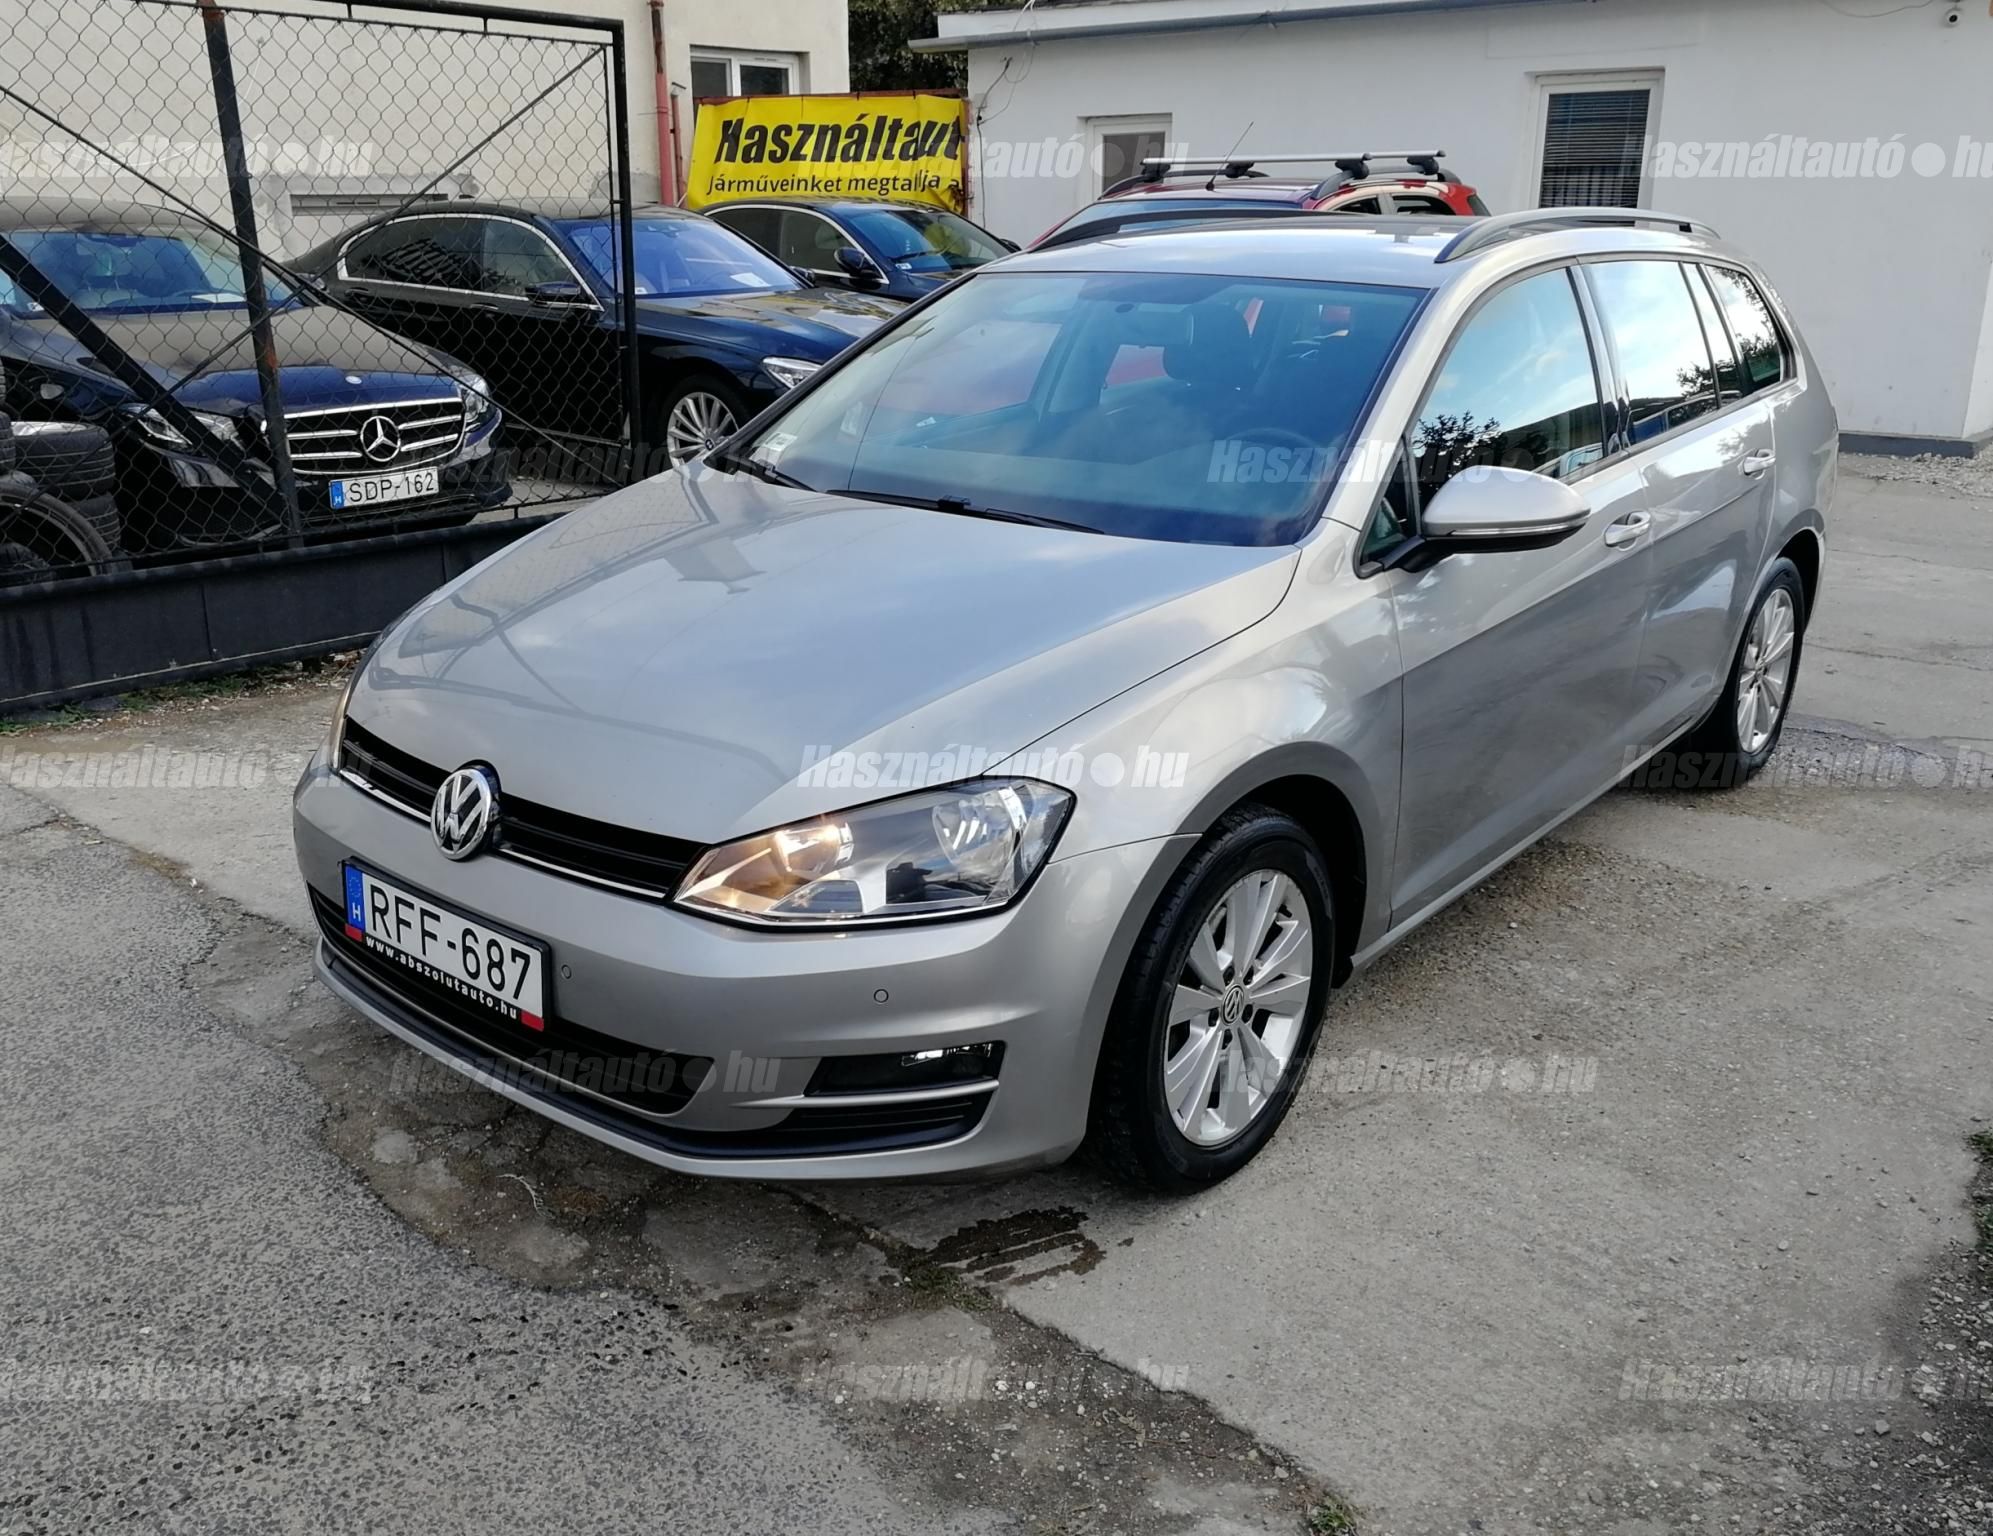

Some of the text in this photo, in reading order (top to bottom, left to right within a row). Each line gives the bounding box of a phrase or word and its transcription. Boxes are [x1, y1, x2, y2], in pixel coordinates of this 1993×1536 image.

[706, 174, 842, 196] Járműveinket
[349, 472, 434, 503] SDP-162
[352, 884, 531, 1000] H RFF-687
[366, 936, 517, 1019] www.abszolutauto.hu
